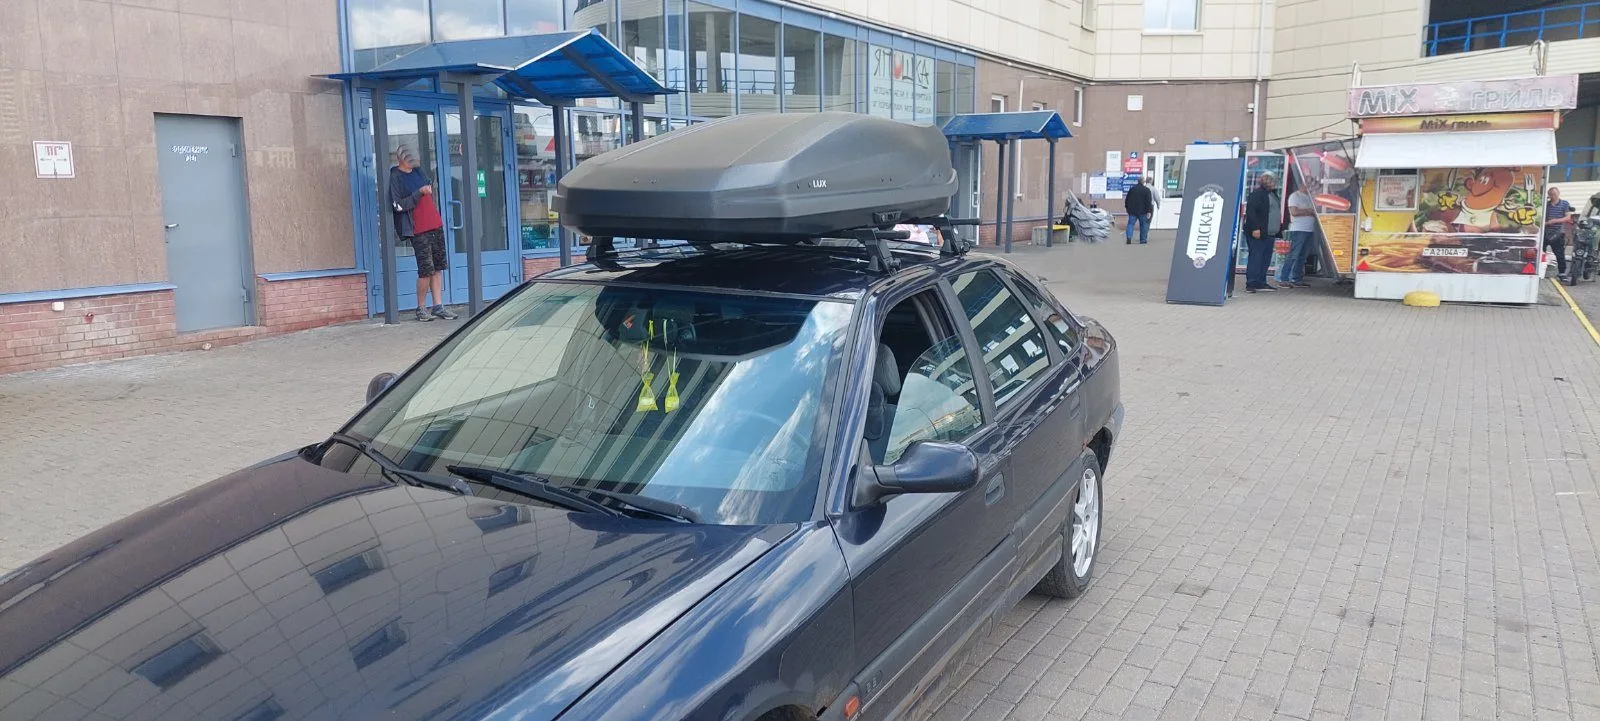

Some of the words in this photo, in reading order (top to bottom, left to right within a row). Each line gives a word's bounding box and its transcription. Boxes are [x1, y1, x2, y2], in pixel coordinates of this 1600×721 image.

[1469, 87, 1563, 110] ГРИЛЬ
[812, 179, 827, 188] LUX
[1194, 202, 1216, 256] ЛІДСКАЕ
